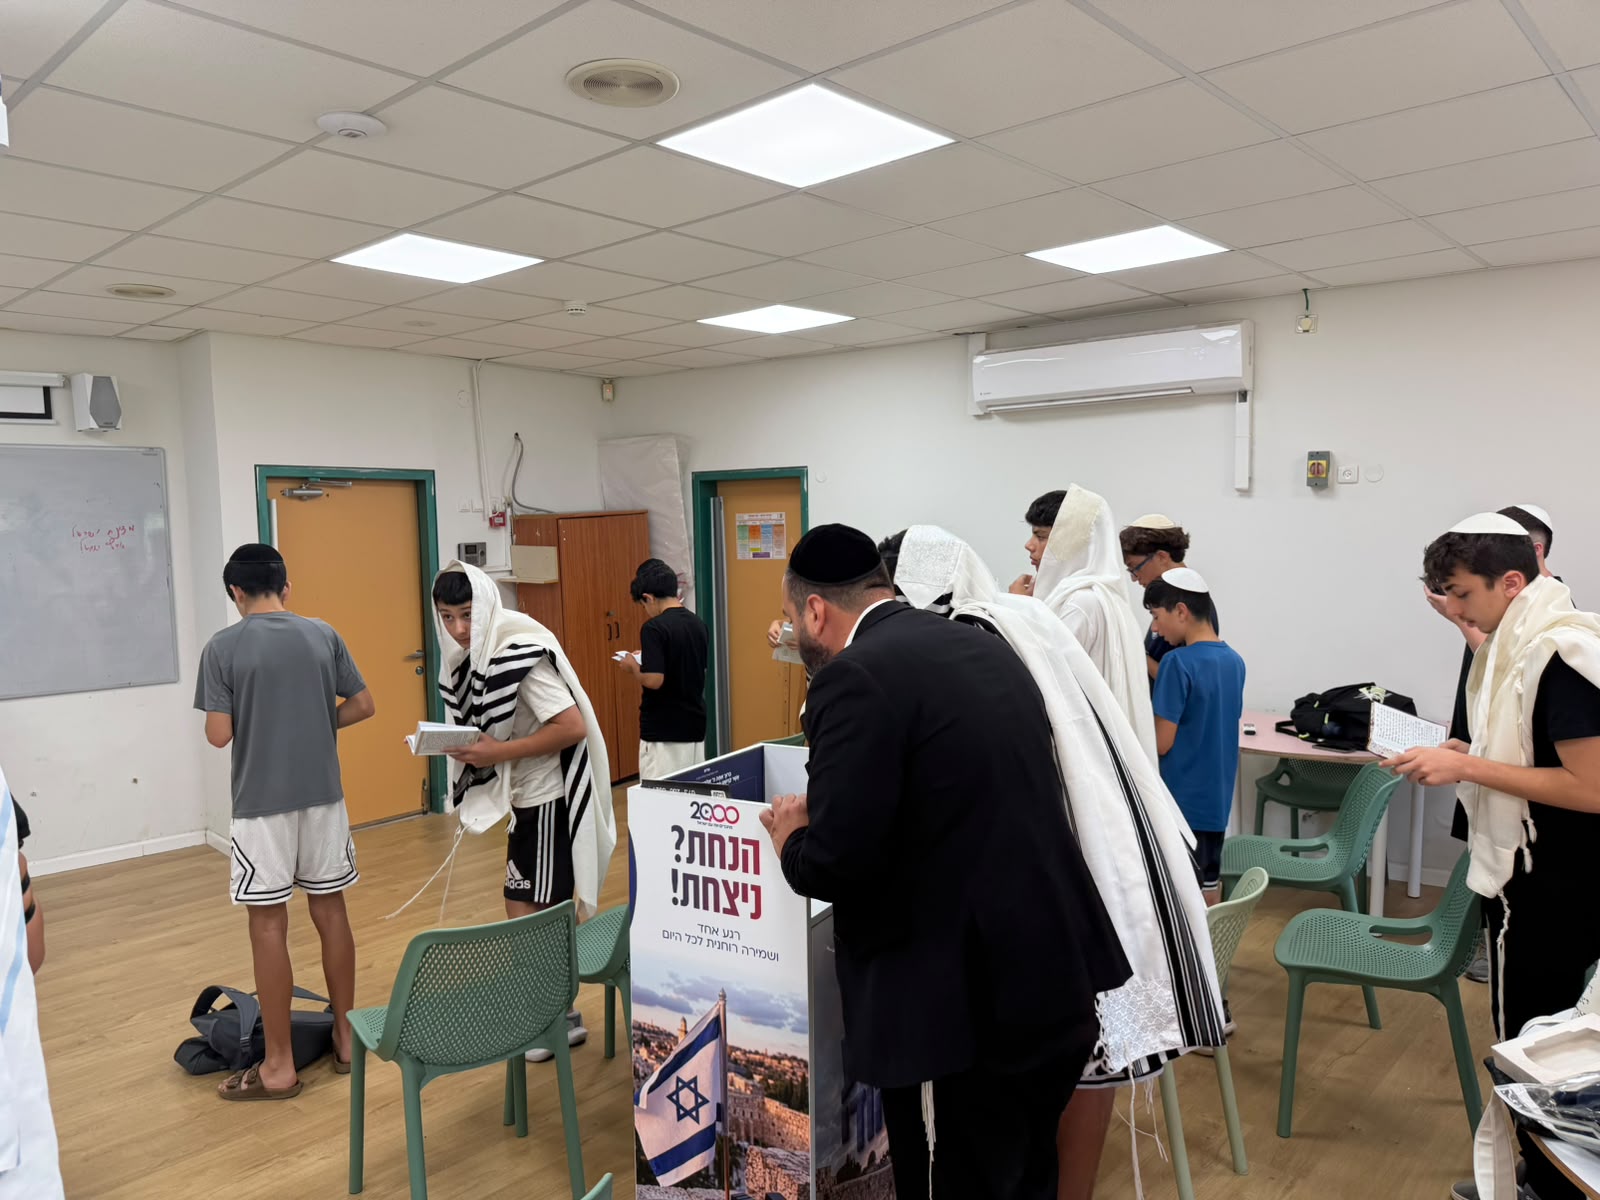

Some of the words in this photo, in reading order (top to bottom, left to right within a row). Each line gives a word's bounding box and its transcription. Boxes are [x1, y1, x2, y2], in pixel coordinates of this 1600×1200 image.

[671, 825, 760, 875] הנחת?
[671, 868, 762, 920] ניצחת!
[662, 929, 682, 942] היום
[697, 923, 719, 936] אחד
[723, 928, 741, 940] רגע
[685, 933, 703, 946] לכל
[706, 938, 738, 953] רוחנית
[741, 945, 779, 962] ושמירה
